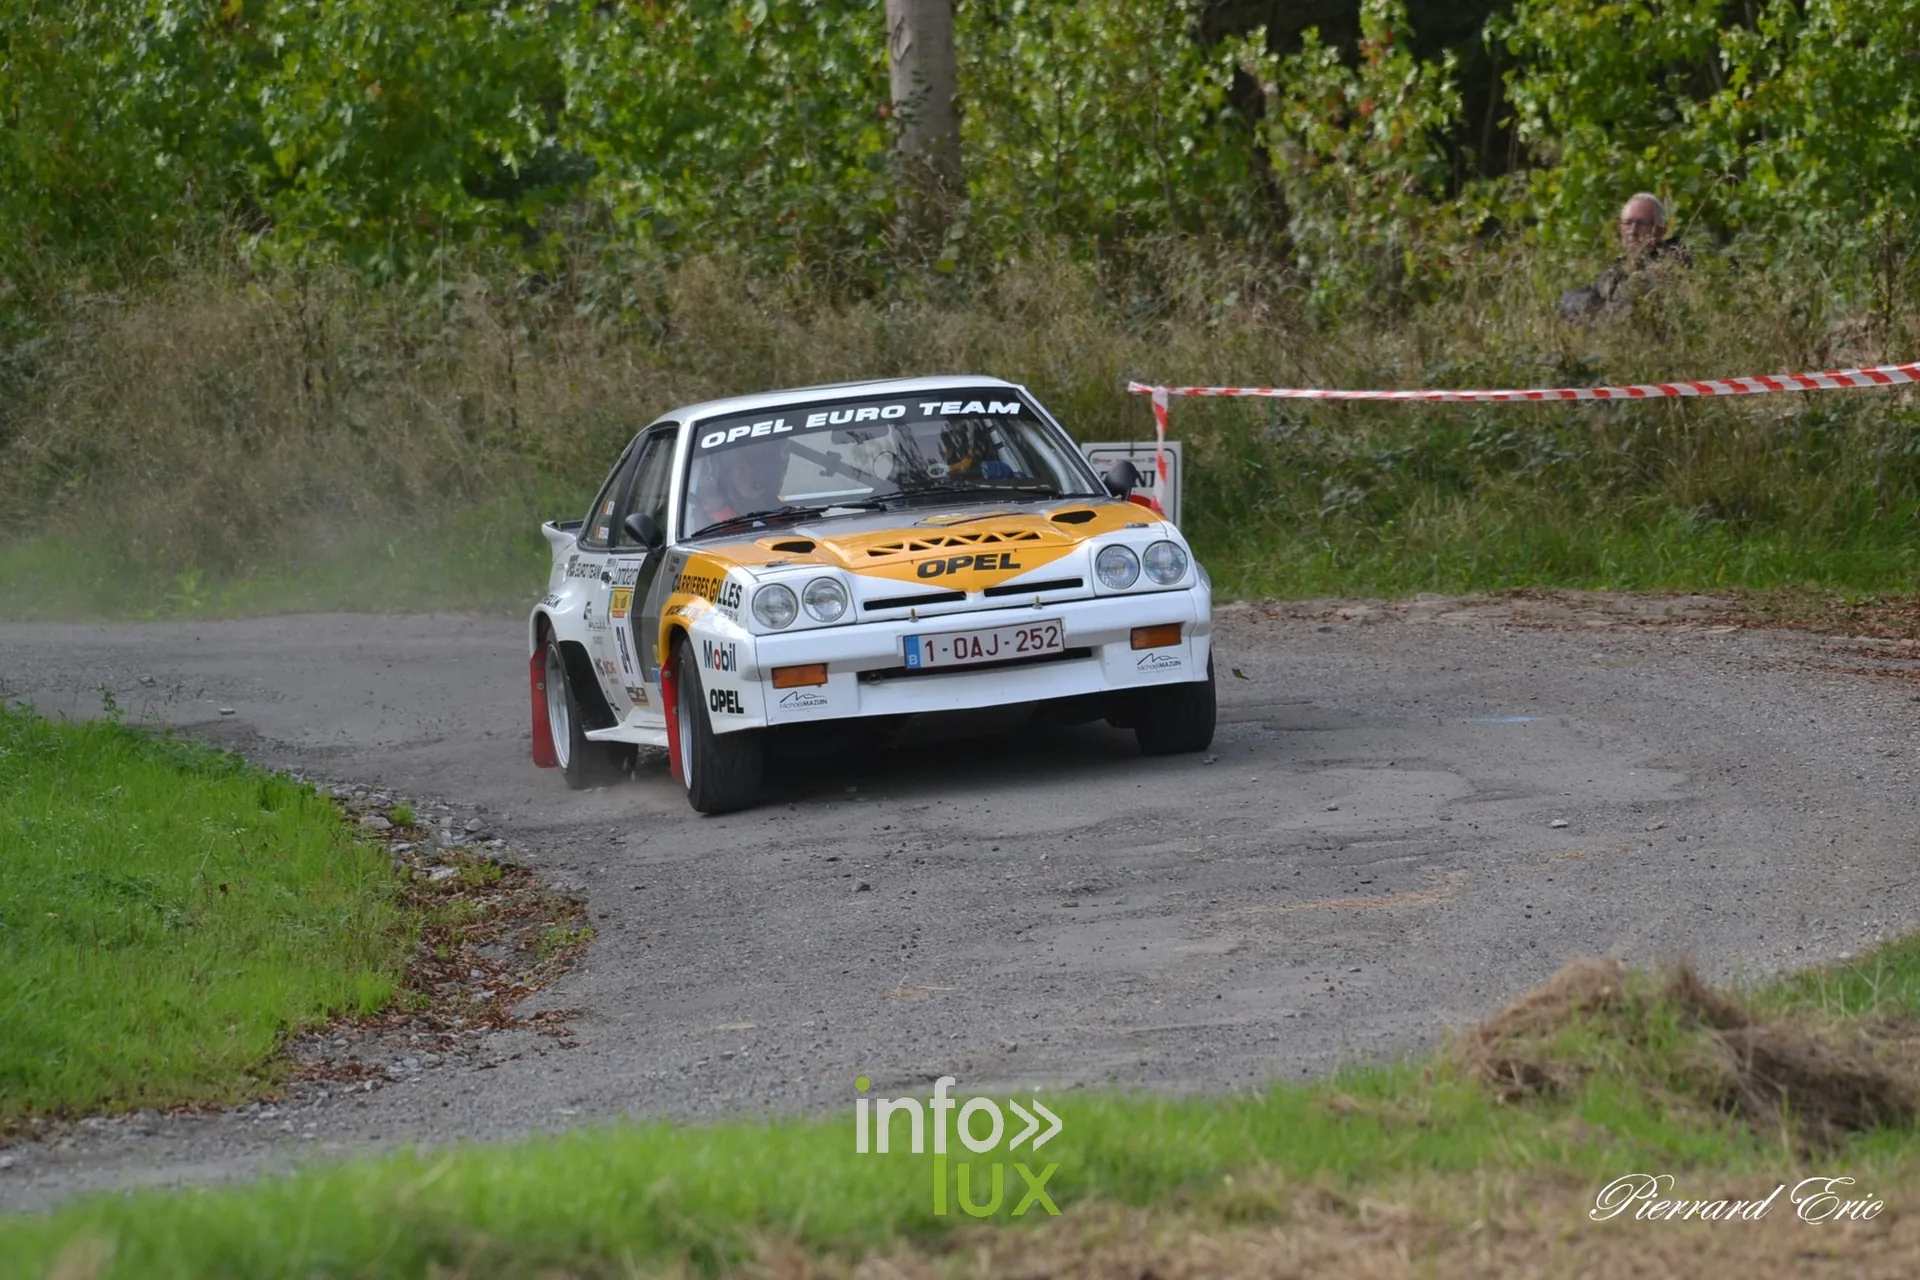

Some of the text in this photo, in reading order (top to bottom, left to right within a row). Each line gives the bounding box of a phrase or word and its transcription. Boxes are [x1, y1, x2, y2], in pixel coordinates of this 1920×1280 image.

[701, 401, 1021, 449] OPEL EURO TEAM
[917, 553, 1021, 579] OPEL
[672, 574, 742, 609] CARRIERES GILLES
[703, 640, 737, 671] Mobil
[909, 655, 918, 665] B
[710, 688, 744, 714] OPEL
